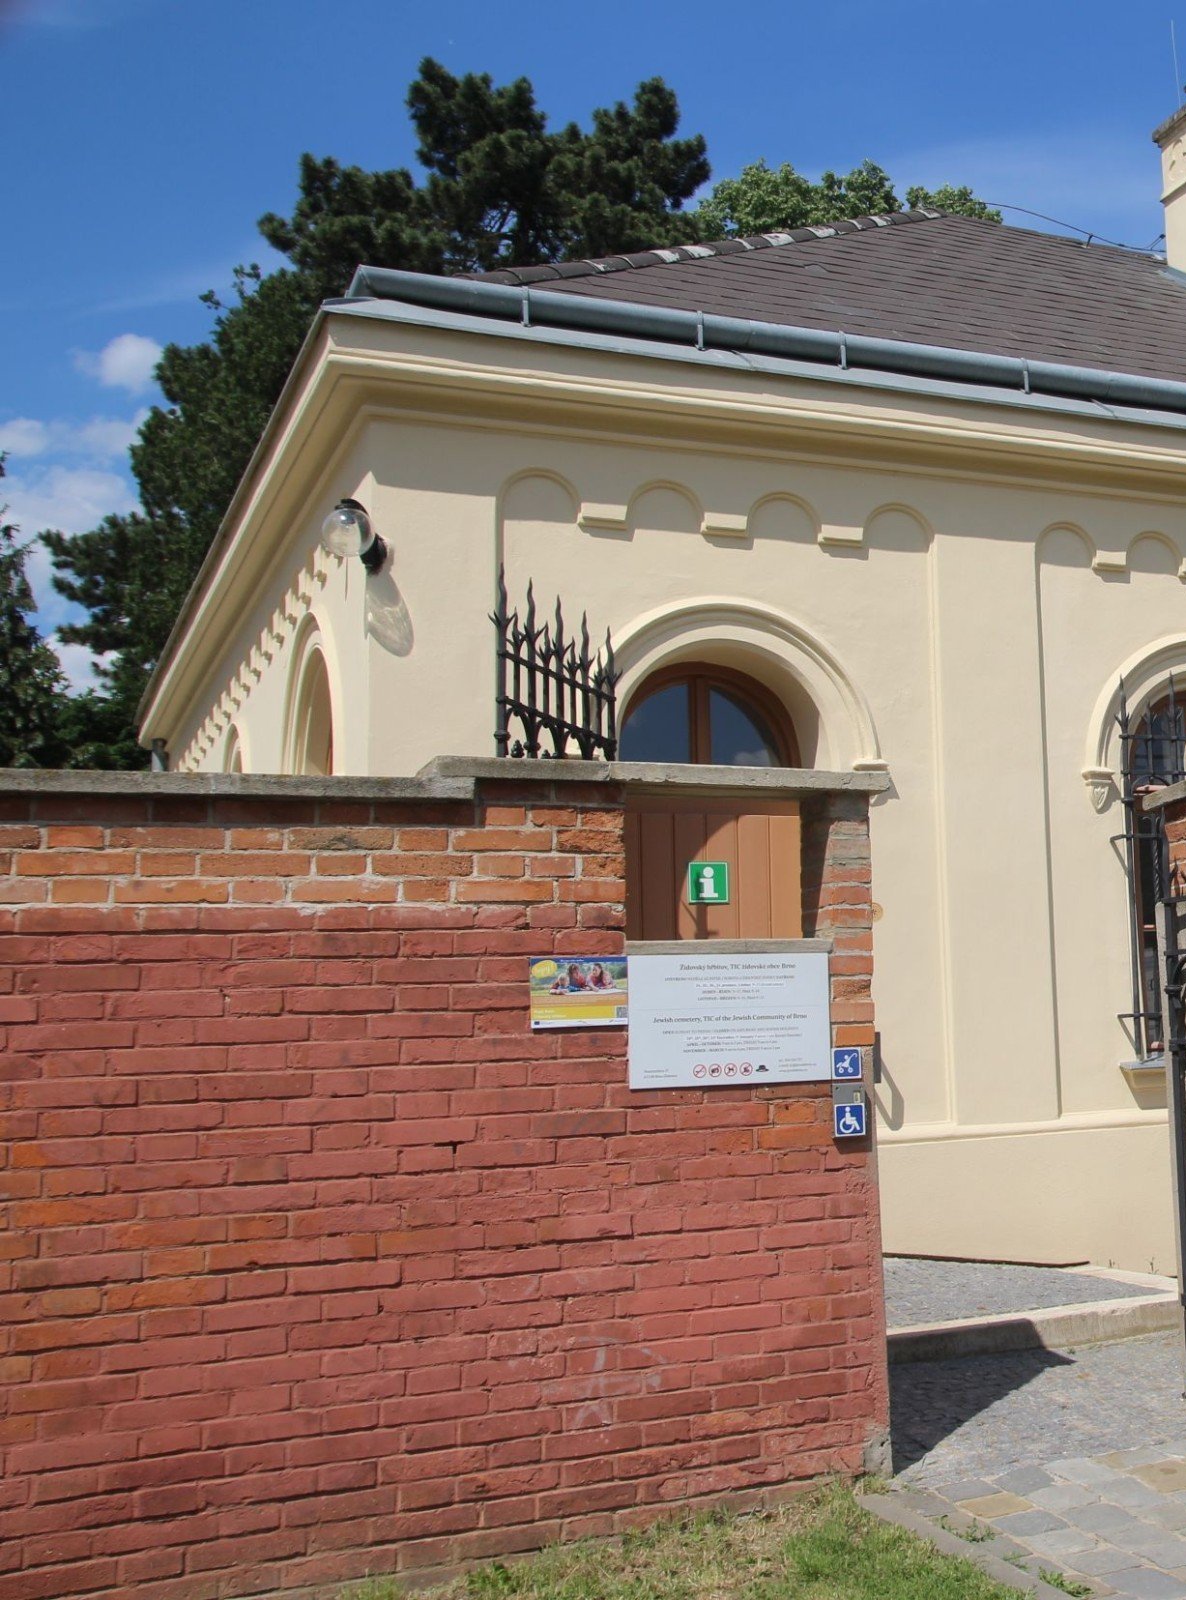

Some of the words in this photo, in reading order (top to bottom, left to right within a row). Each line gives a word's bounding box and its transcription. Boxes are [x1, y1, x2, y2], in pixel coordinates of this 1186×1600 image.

[781, 962, 796, 970] Brno
[653, 1016, 674, 1024] Jewish
[674, 1016, 702, 1024] cemetery,
[733, 1014, 752, 1022] Jewish
[752, 1013, 786, 1022] Community
